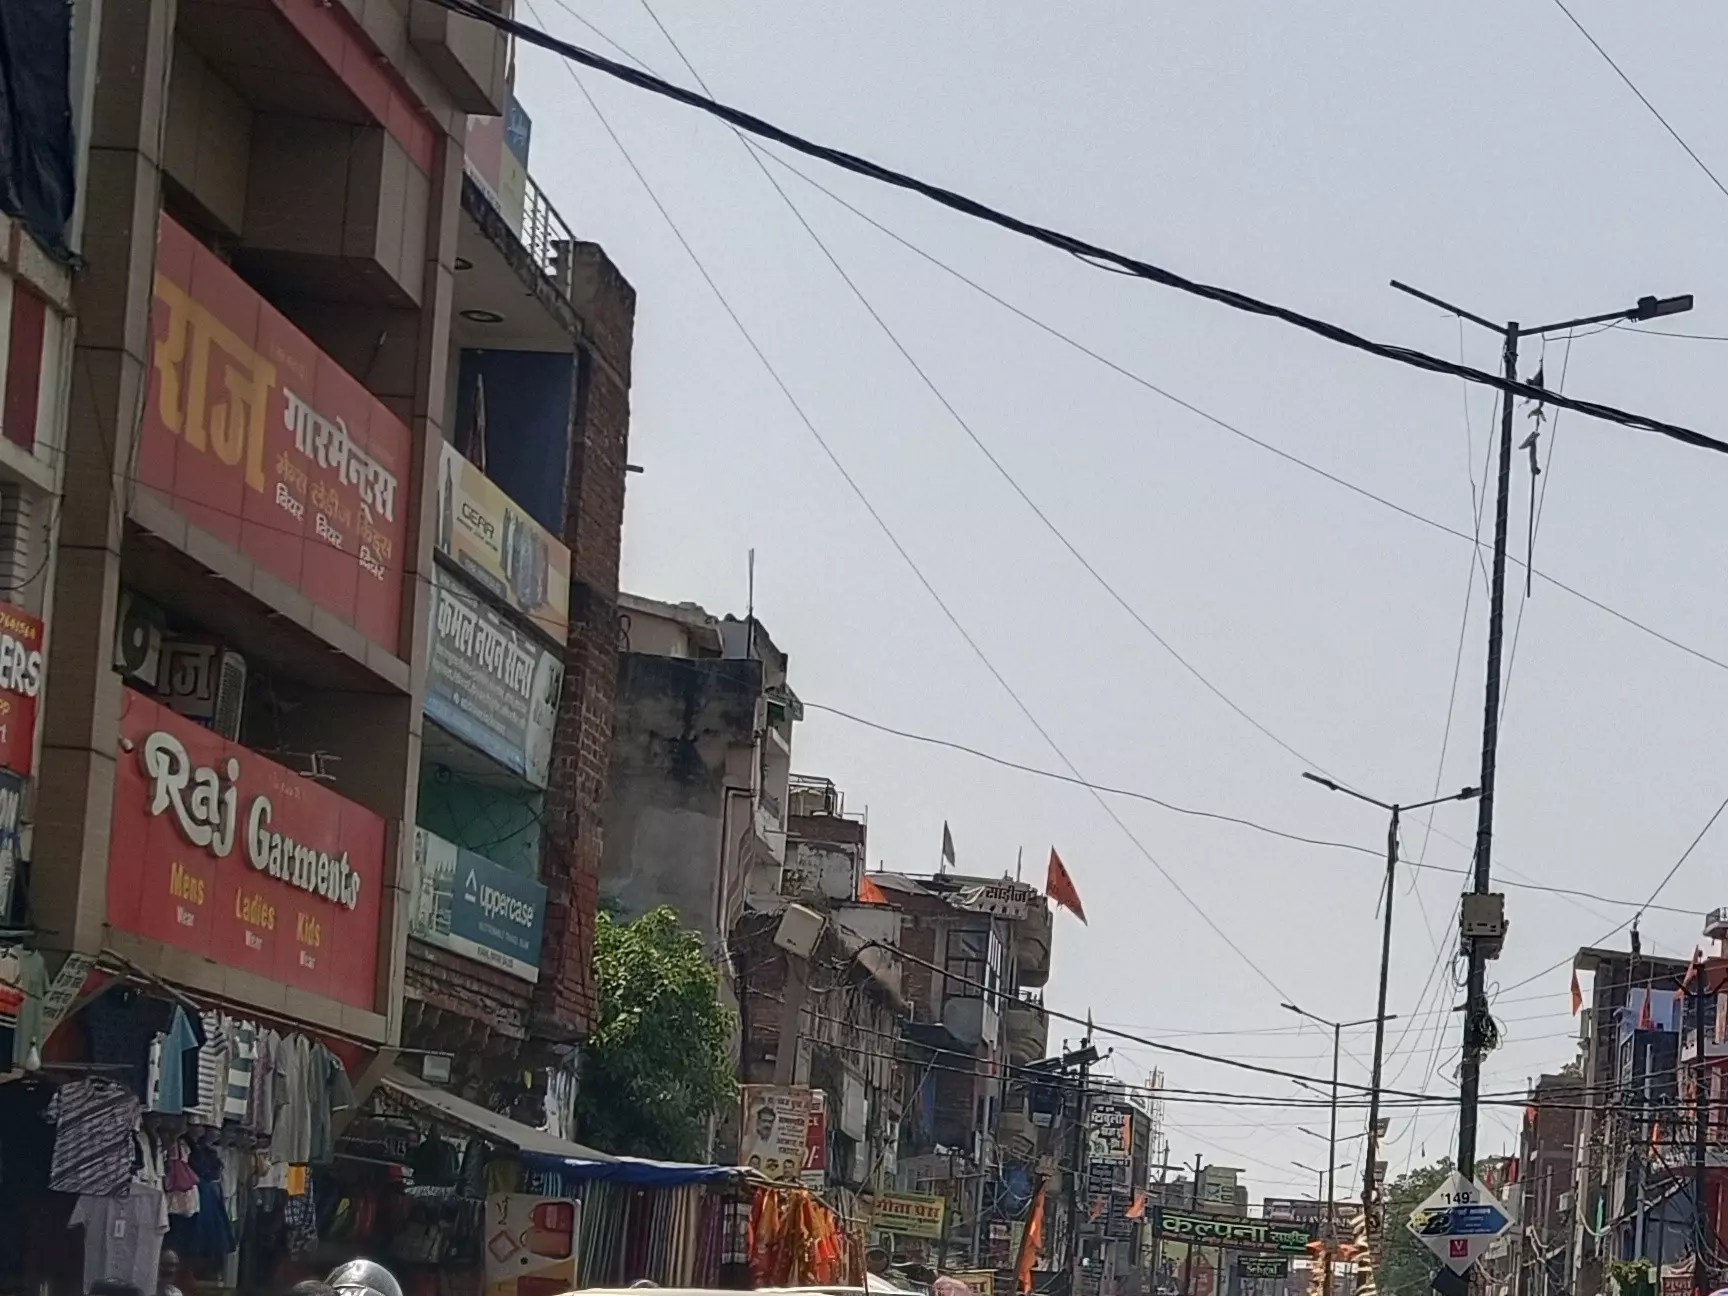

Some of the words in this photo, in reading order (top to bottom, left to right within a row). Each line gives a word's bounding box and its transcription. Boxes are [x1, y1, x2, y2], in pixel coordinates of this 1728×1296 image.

[153, 268, 277, 494] राज
[144, 731, 240, 858] Raj
[249, 796, 361, 911] Garments
[170, 862, 205, 905] Mens
[236, 888, 276, 931] Ladies
[296, 912, 322, 948] Kids
[480, 884, 535, 929] uppercase
[1162, 1214, 1269, 1242] कल्पना
